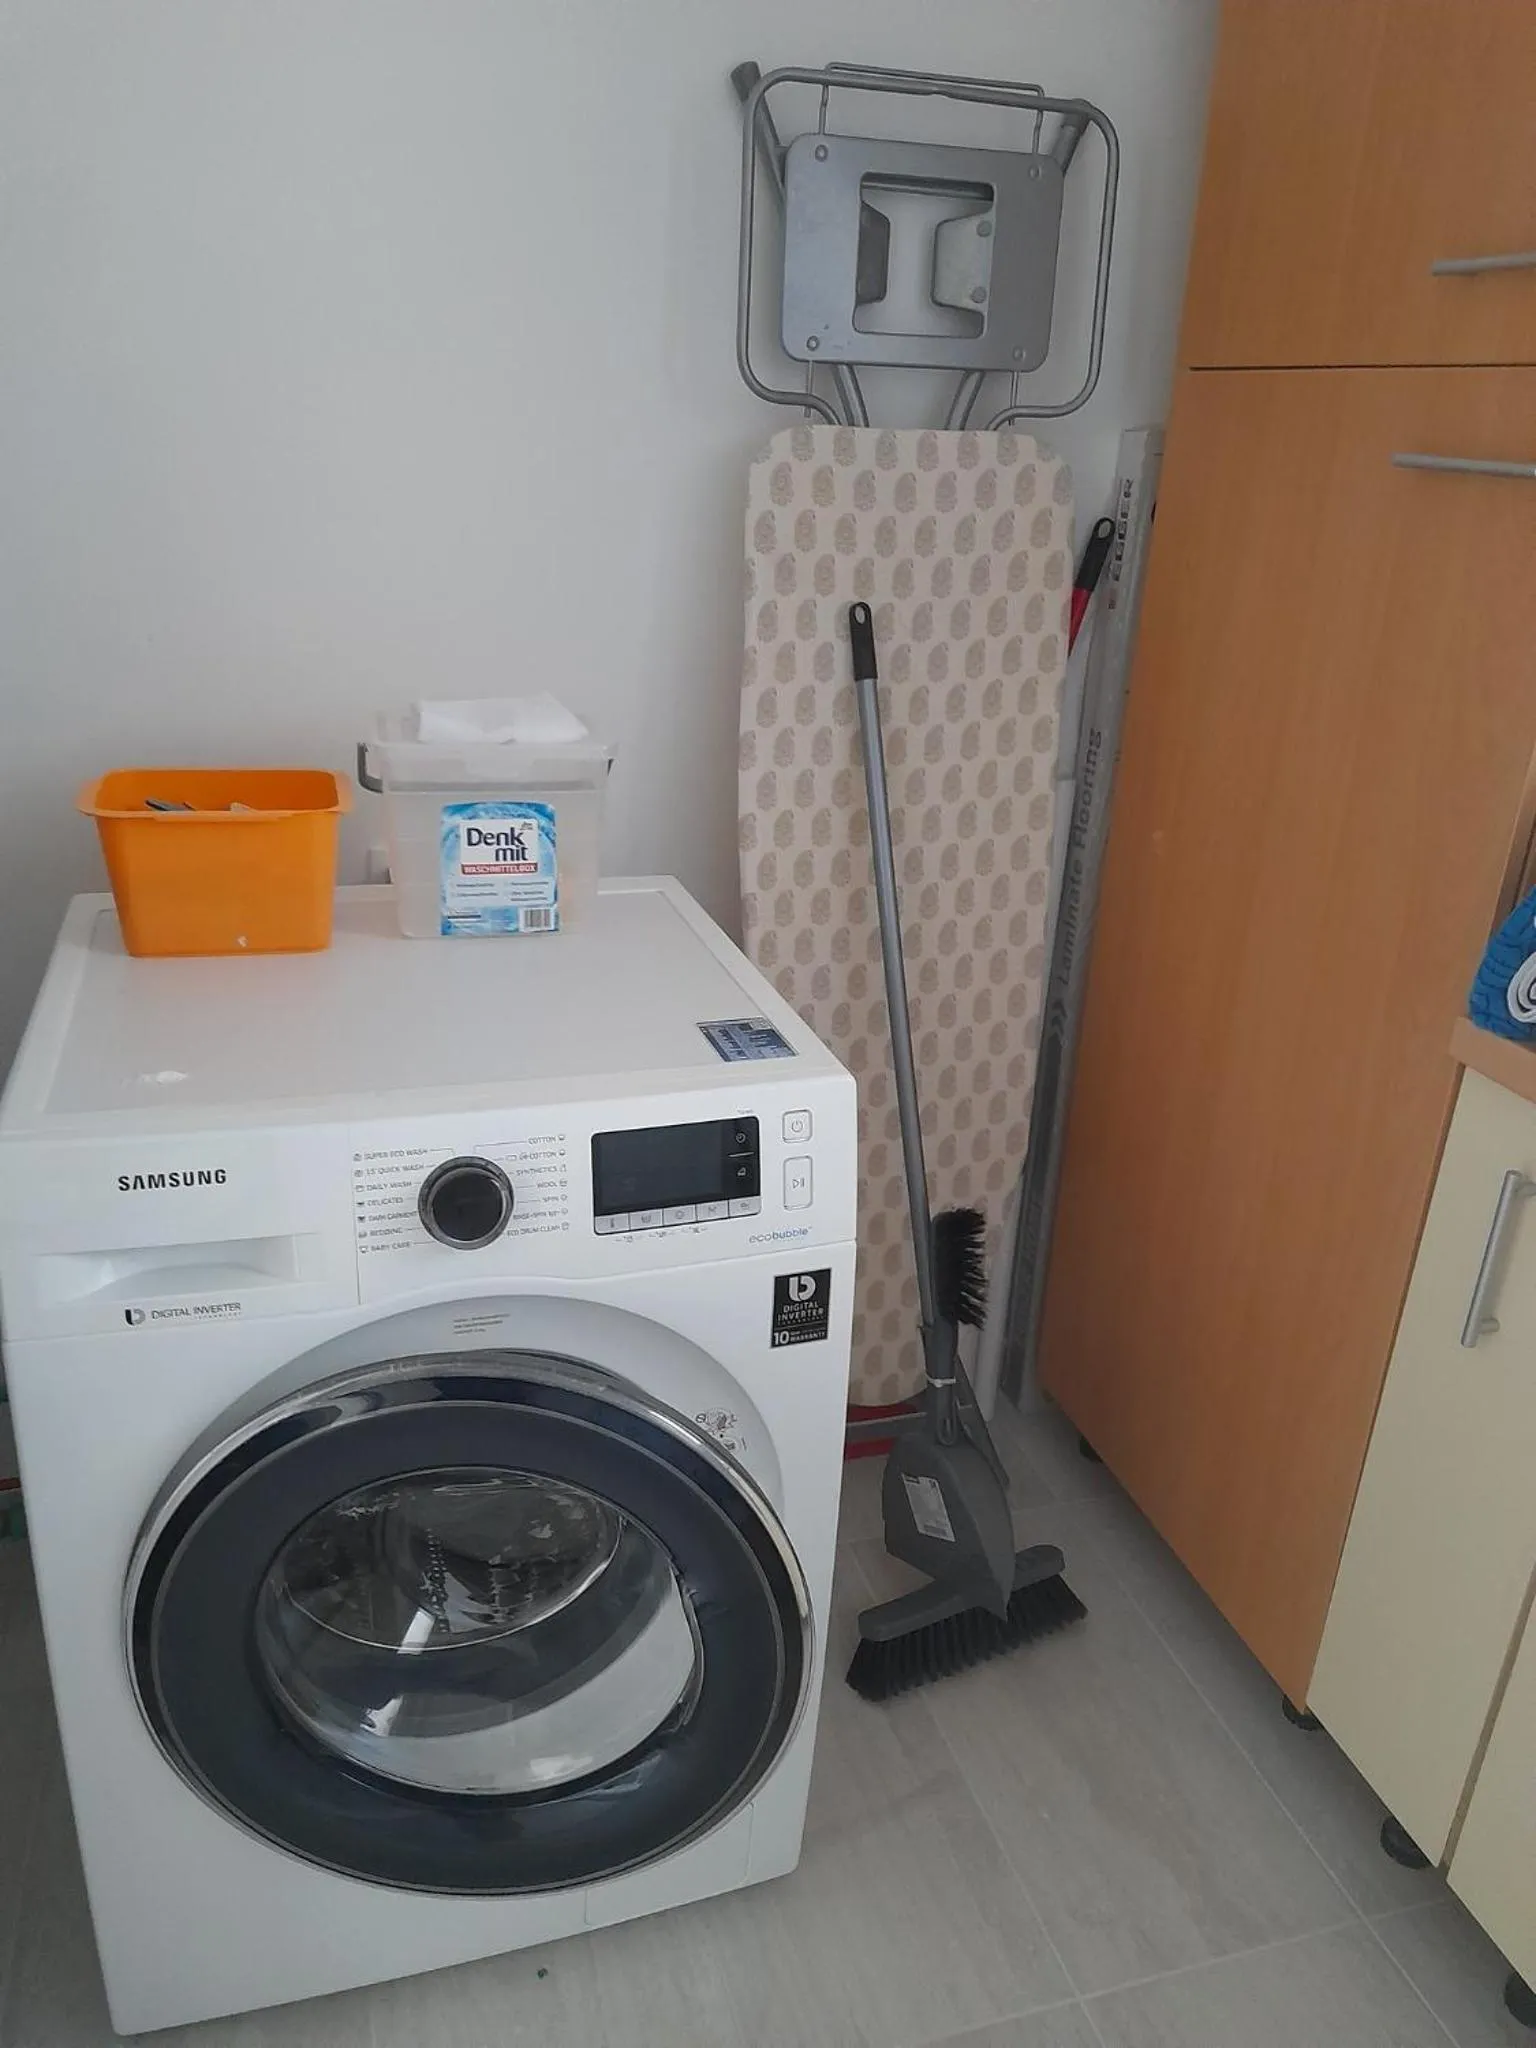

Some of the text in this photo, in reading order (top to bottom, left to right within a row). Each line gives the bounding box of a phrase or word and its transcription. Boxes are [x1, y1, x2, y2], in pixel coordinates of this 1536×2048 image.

[1109, 478, 1133, 582] EGGER
[466, 827, 525, 847] Denk
[495, 845, 529, 862] mit
[1057, 727, 1102, 986] Laminate Flooring
[118, 1168, 227, 1191] SAMSUNG
[151, 1308, 191, 1320] DIGITAL
[193, 1302, 242, 1314] INVERTER
[777, 1307, 824, 1322] INVERTER
[783, 1301, 819, 1313] DIGITAL
[773, 1331, 790, 1346] 10
